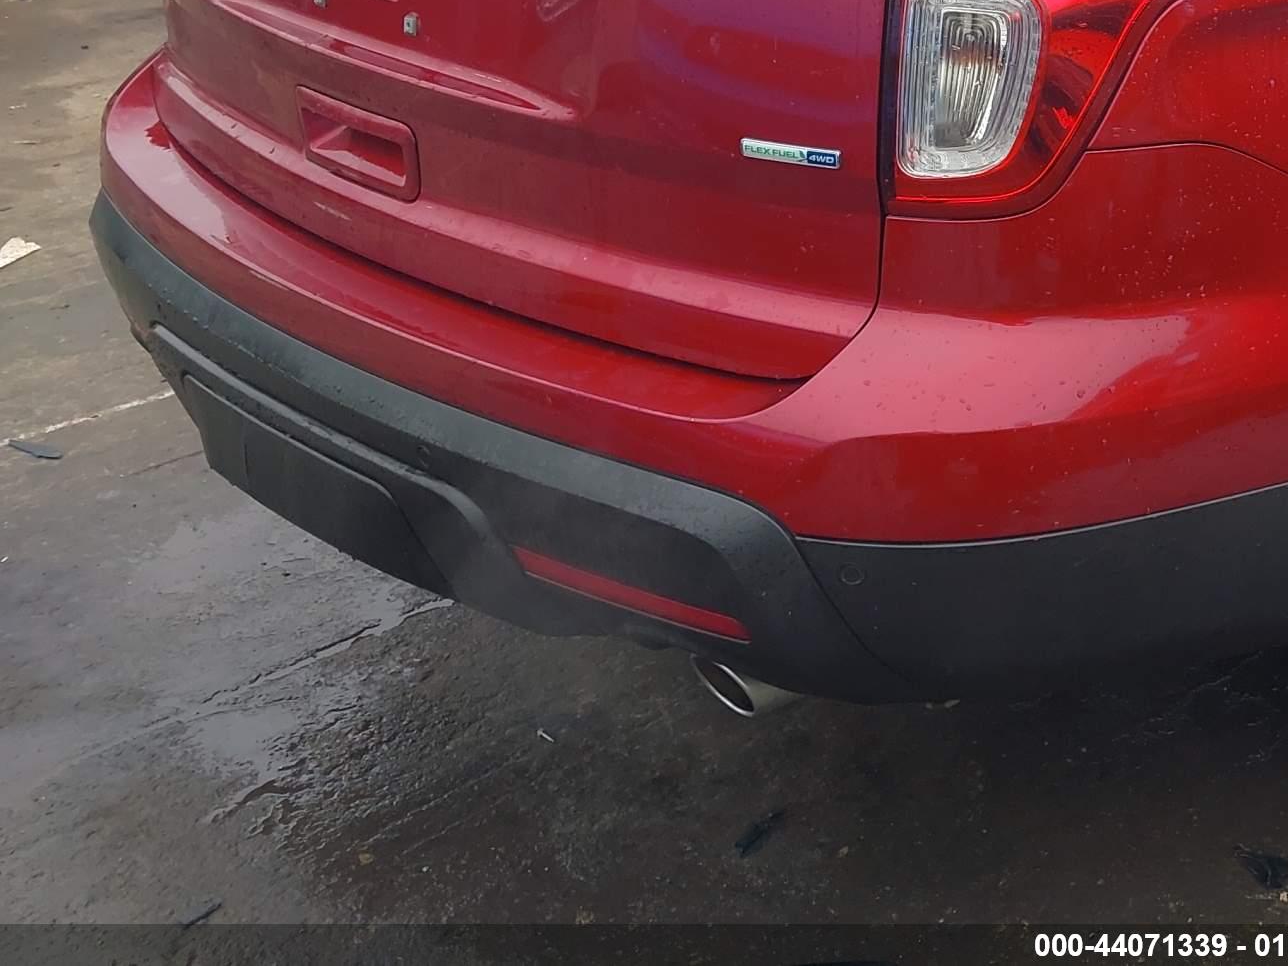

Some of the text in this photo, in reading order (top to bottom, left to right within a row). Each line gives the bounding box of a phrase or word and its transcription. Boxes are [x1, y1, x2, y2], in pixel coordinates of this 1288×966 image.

[744, 144, 799, 159] FLEX FUEL
[808, 153, 835, 164] 4WD
